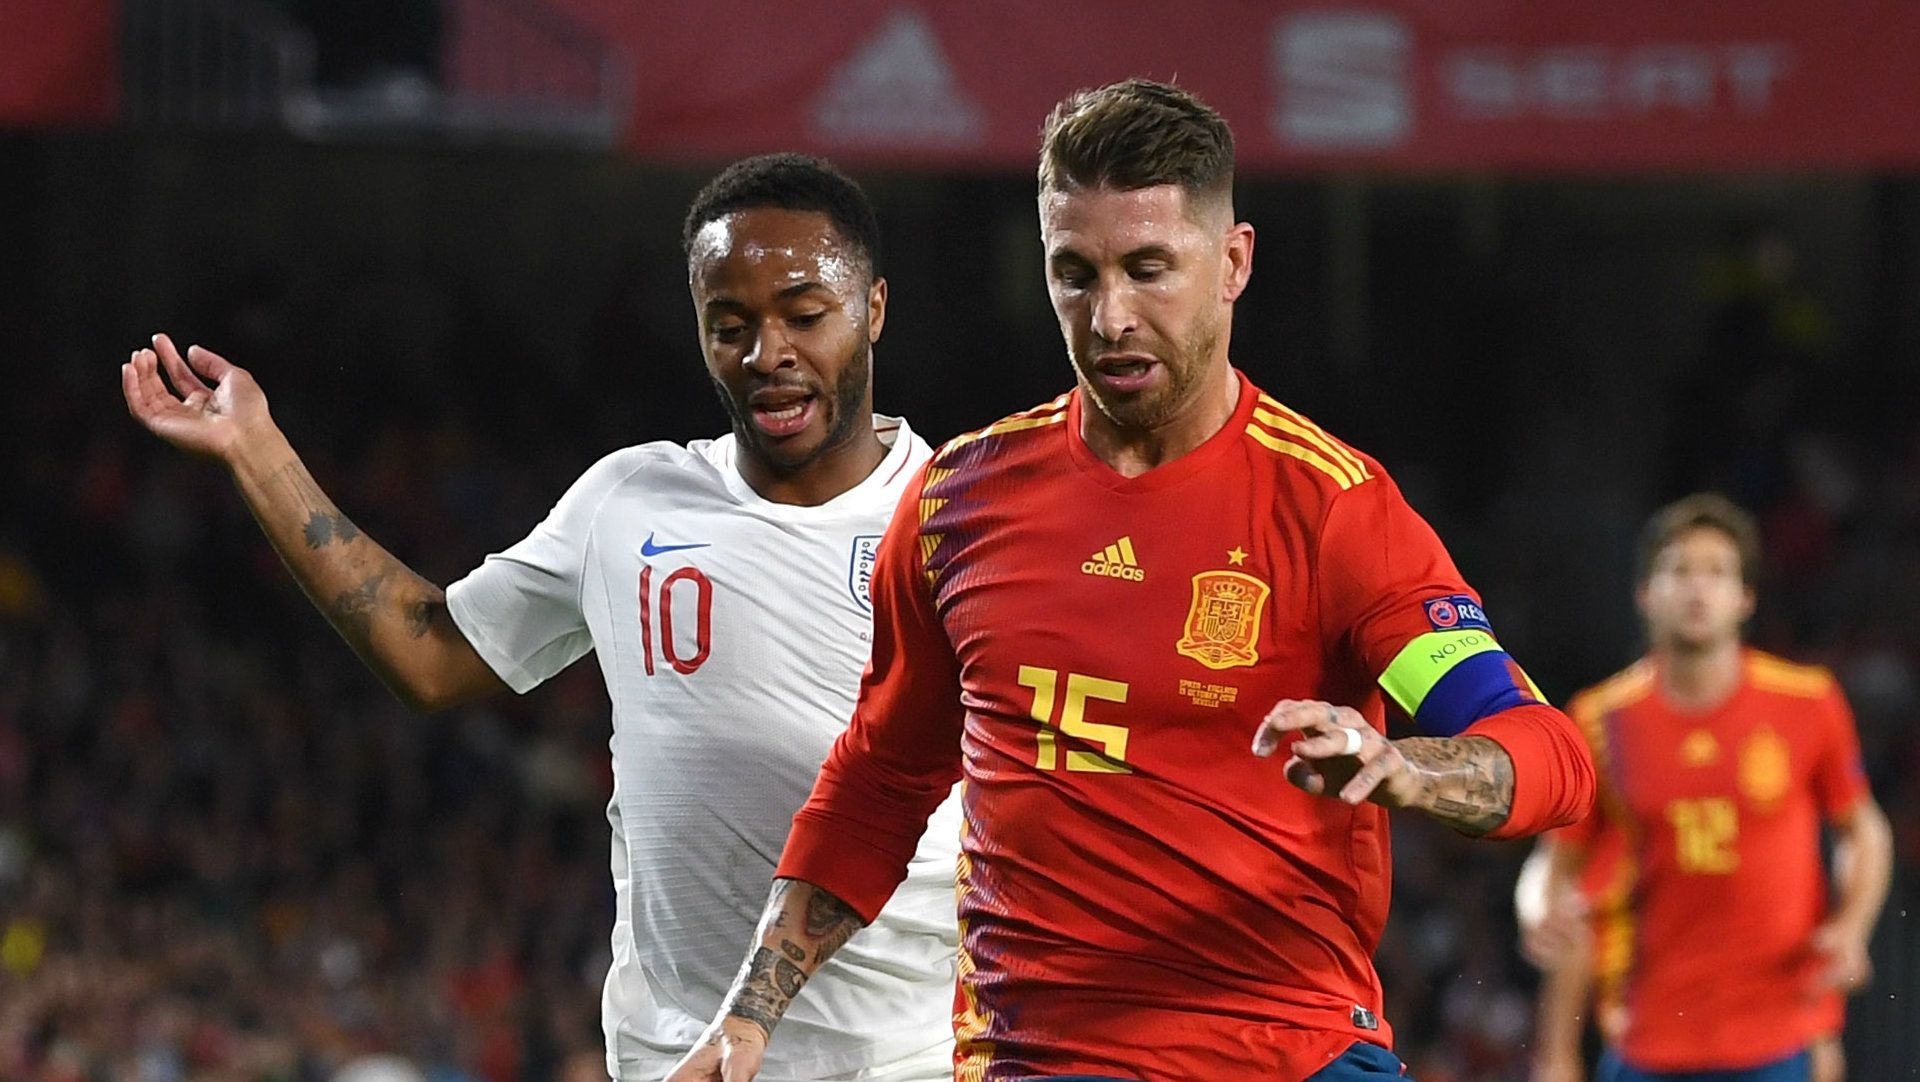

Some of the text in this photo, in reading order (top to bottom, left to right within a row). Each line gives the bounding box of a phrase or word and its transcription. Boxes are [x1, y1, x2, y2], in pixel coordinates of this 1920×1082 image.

[1081, 560, 1146, 582] adidas
[639, 565, 712, 676] 10
[1430, 643, 1456, 663] NO
[1457, 636, 1479, 647] TO
[1017, 664, 1133, 774] 15
